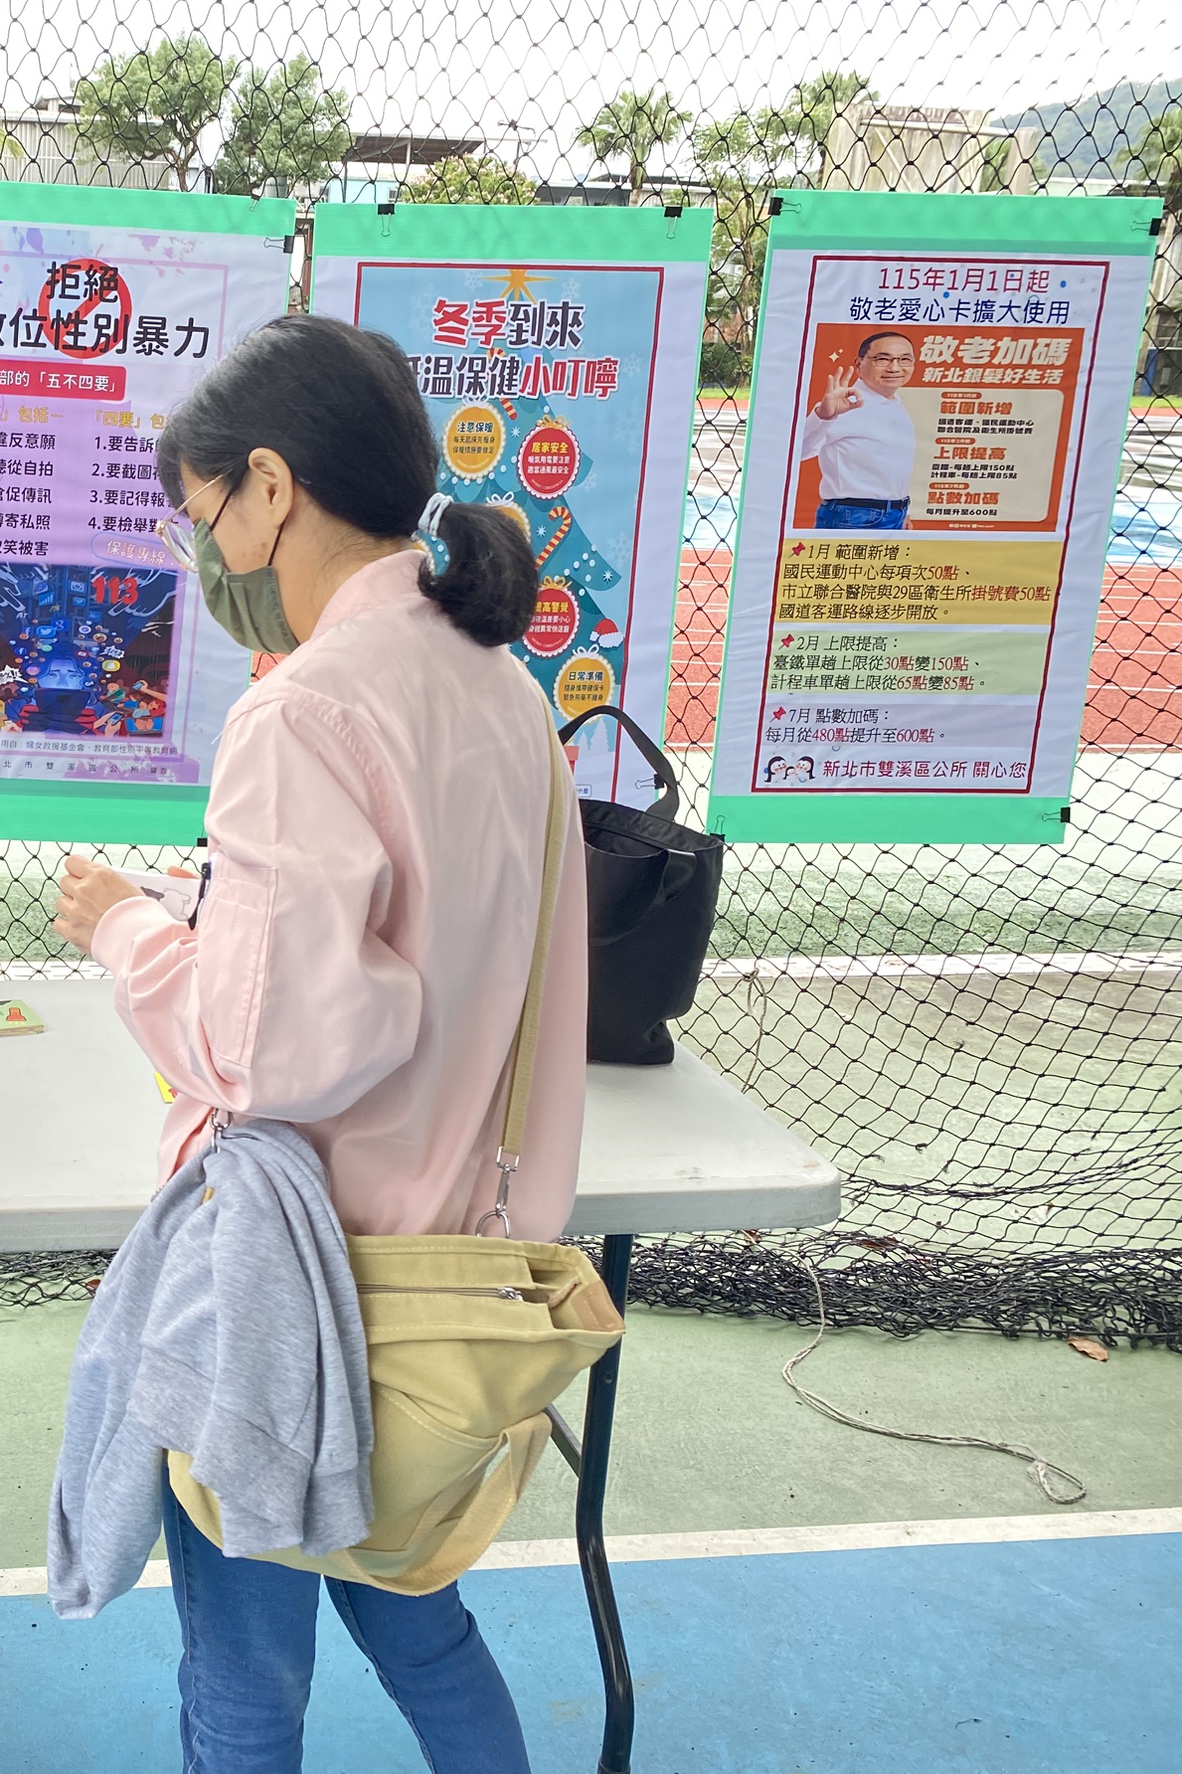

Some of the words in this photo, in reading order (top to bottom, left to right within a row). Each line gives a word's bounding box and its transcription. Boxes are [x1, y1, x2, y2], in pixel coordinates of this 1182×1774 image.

[46, 261, 119, 303] 拒絕
[878, 267, 1051, 293] 115年1月1日起
[850, 296, 1070, 325] 敬老愛心卡擴大使用
[432, 299, 585, 347] 冬季到來
[919, 335, 1072, 366] 敬老加碼
[922, 367, 1064, 385] 新北銀髮好生活
[940, 401, 1013, 415] 範圍新增
[95, 410, 169, 430] 「四要」包
[457, 421, 494, 433] 注意保暖
[94, 436, 160, 453] 1.要告訴
[531, 441, 569, 454] 居家安全
[933, 446, 1007, 460] 上限提高
[90, 489, 172, 508] 3.要記得報
[927, 491, 1000, 505] 點數加碼
[106, 540, 166, 565] 保護專線
[808, 544, 830, 560] 1月
[92, 576, 138, 605] 113
[782, 583, 1051, 602] 市立聯合醫院與29區衛生所掛號費50點
[796, 636, 820, 651] 2月
[568, 671, 604, 681] 日常準備
[789, 708, 811, 724] 7月
[823, 761, 967, 779] 新北市雙溪區公所
[972, 761, 1027, 779] 關心您
